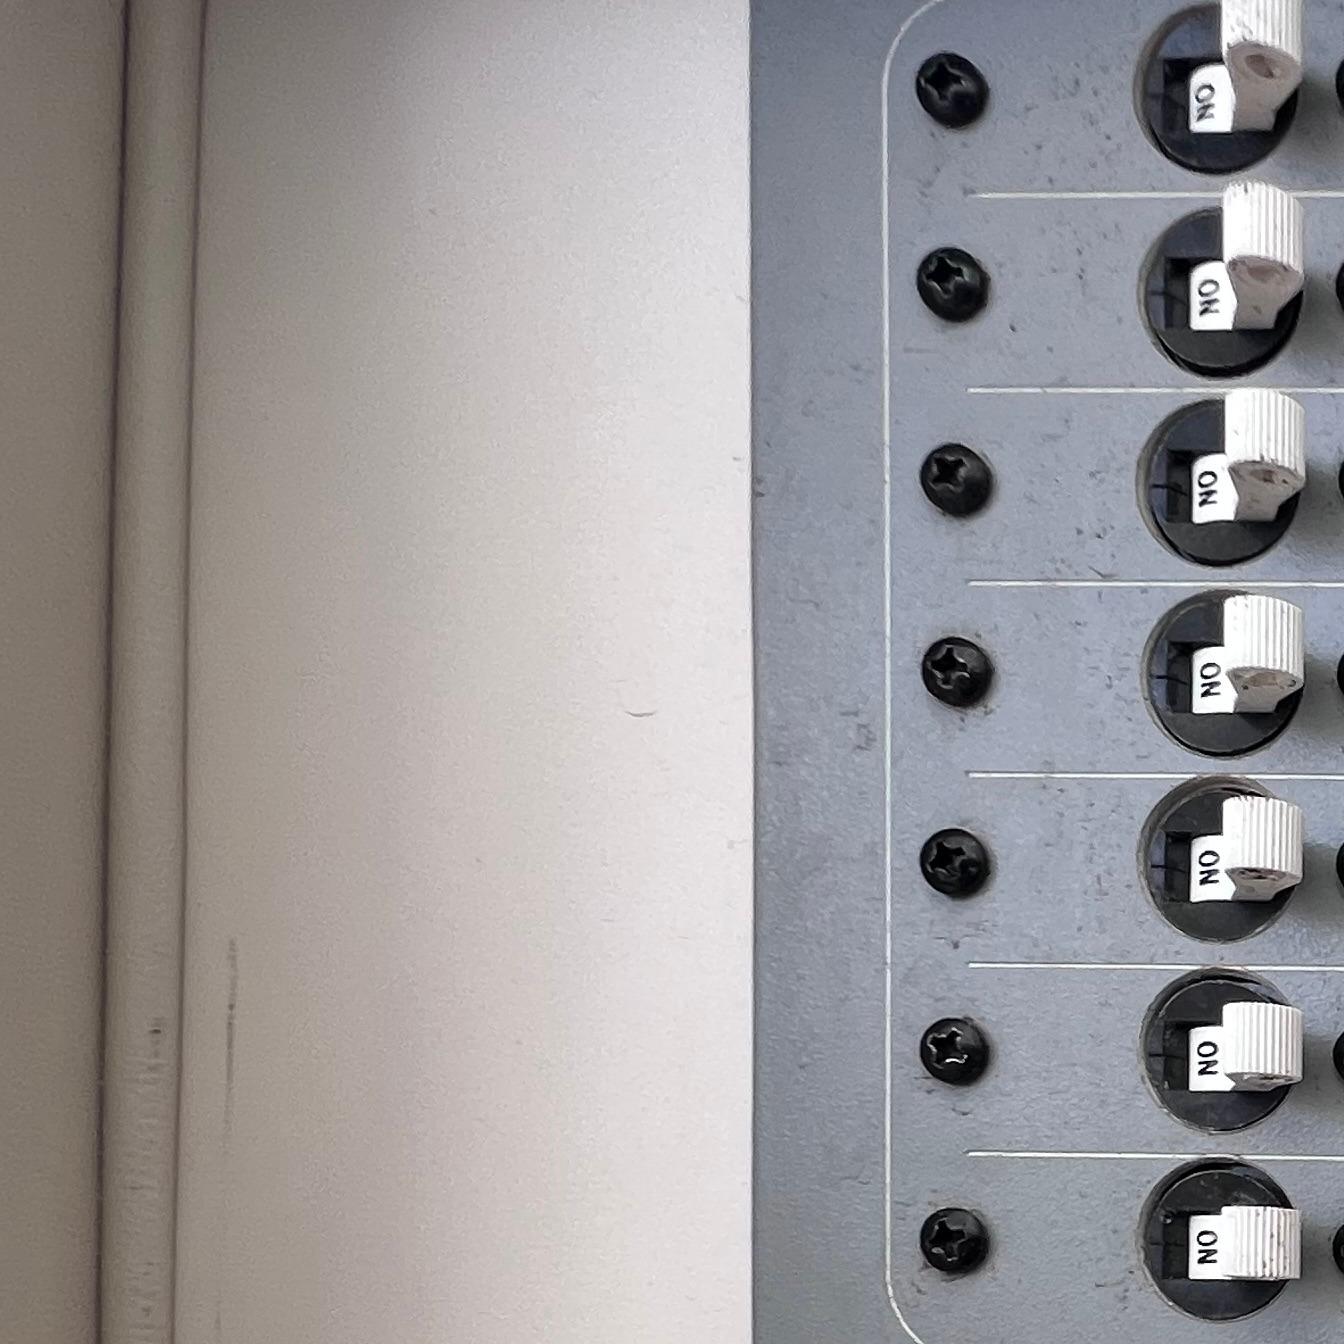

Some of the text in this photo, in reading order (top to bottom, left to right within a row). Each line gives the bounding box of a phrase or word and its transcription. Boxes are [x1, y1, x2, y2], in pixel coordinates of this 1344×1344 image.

[1198, 278, 1220, 317] ON
[1197, 469, 1219, 508] ON
[1200, 661, 1223, 700] ON
[1198, 849, 1221, 888] ON
[1196, 1040, 1219, 1079] ON
[1196, 1229, 1219, 1268] ON
